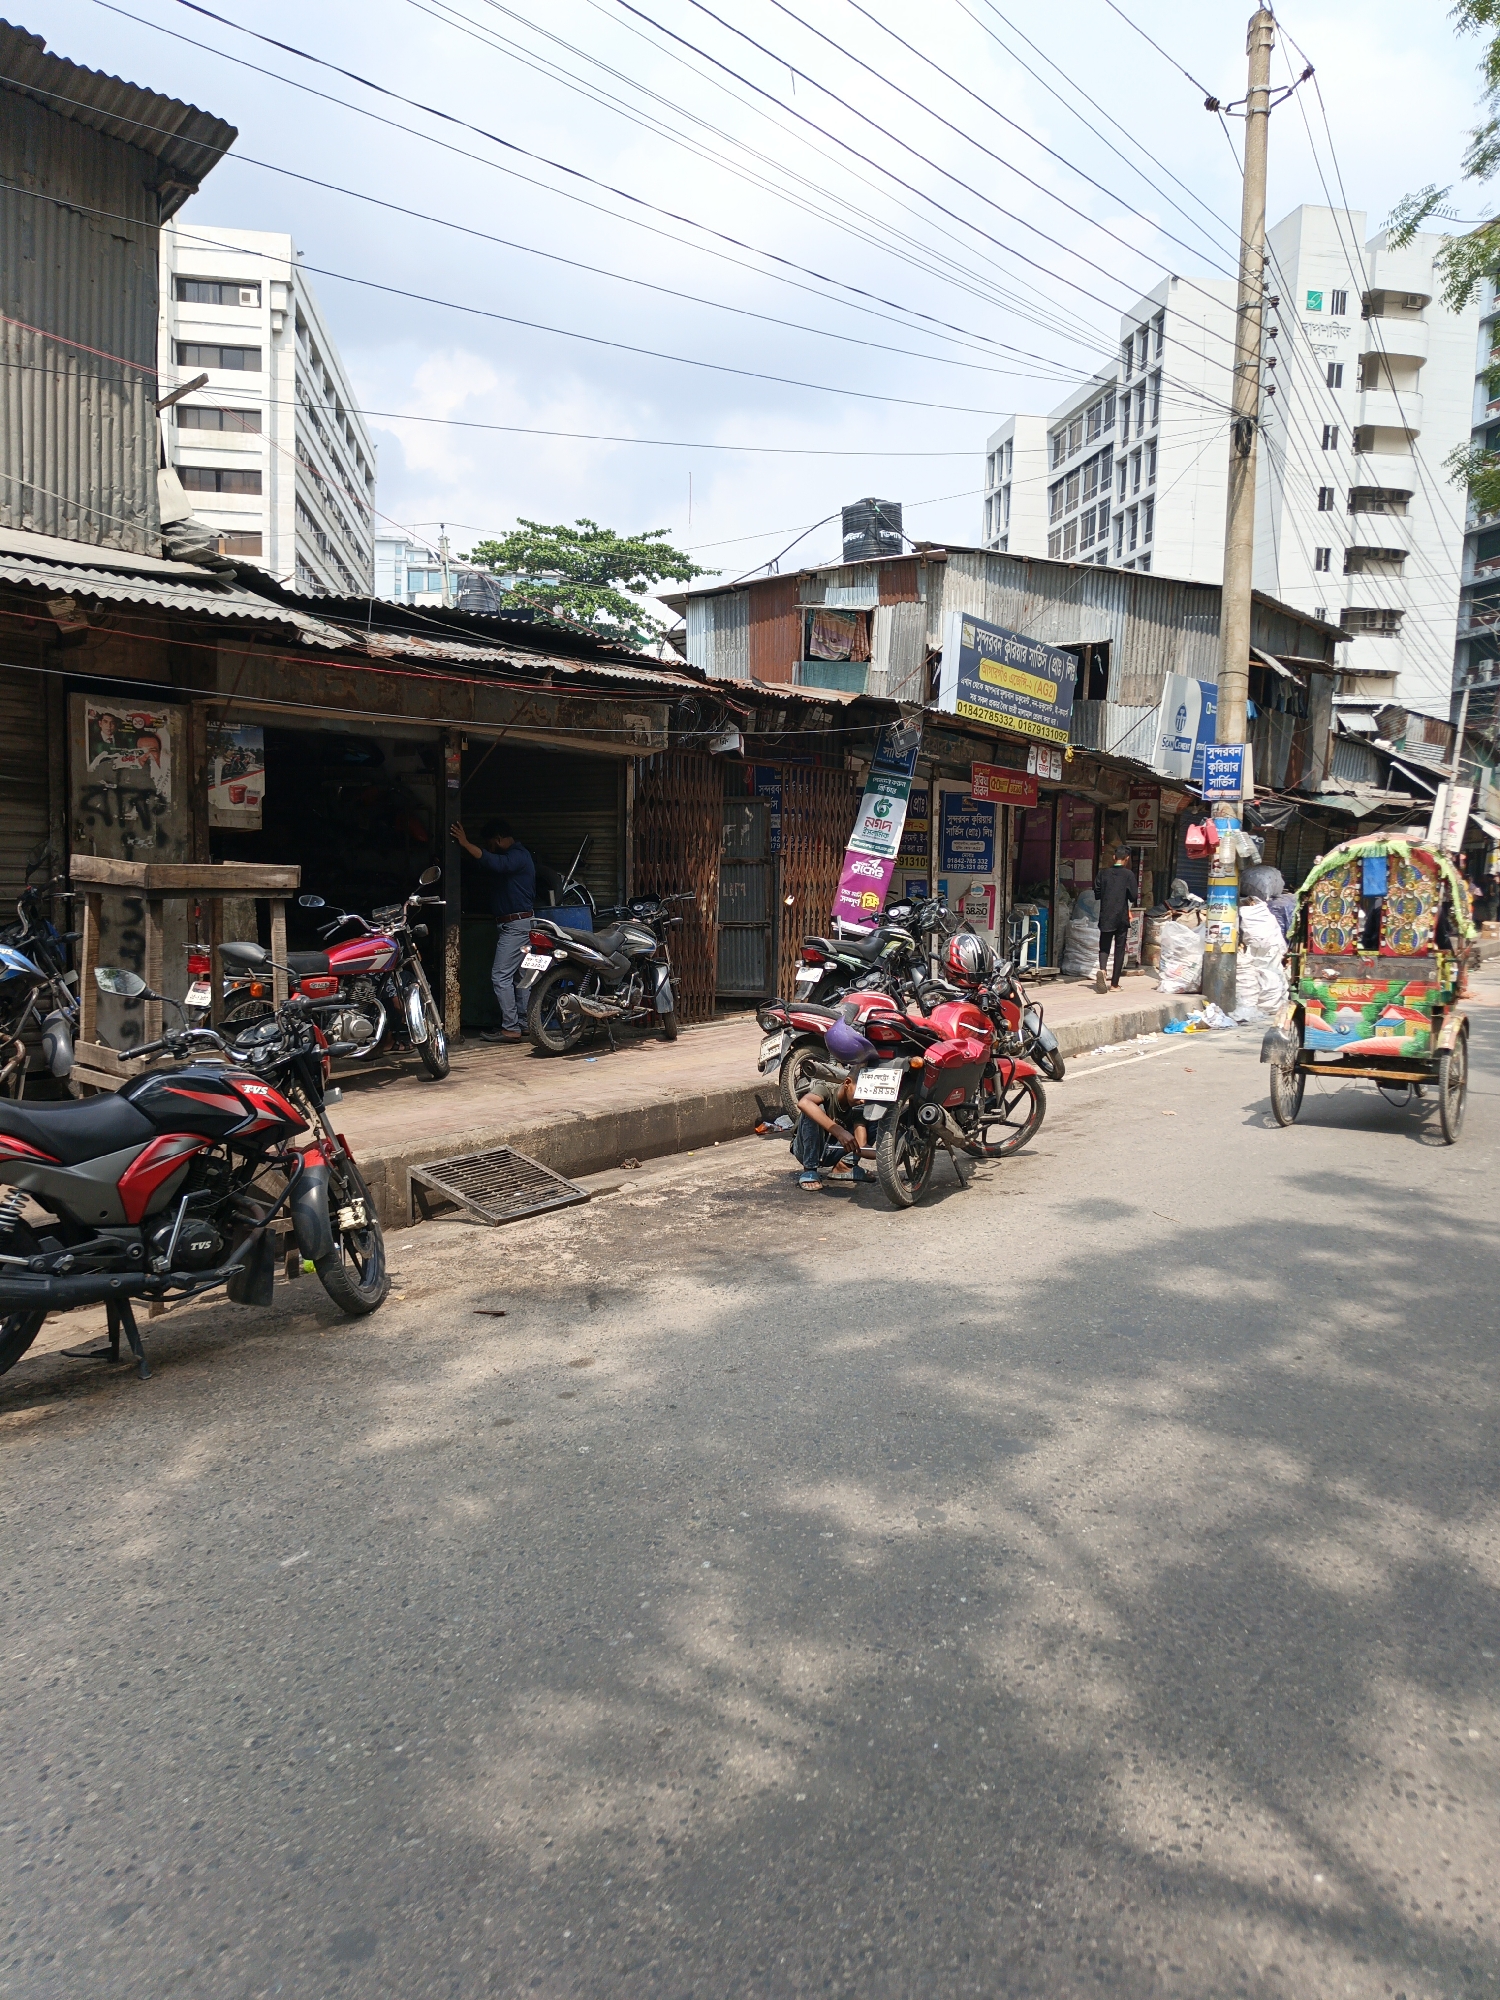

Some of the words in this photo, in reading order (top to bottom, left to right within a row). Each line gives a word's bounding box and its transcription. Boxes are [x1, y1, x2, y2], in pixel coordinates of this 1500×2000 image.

[976, 627, 1003, 656] সুন্দরবন
[1004, 634, 1029, 665] কুরিয়ার
[1029, 644, 1048, 671] সার্ভিস
[1034, 680, 1057, 702] (AG2)
[957, 701, 1015, 729] 01842785332,
[1018, 719, 1068, 742] 01879131092
[1207, 746, 1242, 759] সুন্দরবন
[1207, 760, 1240, 775] কুরিয়ার
[1208, 774, 1237, 788] সার্ভিস
[864, 816, 893, 833] নগদ
[947, 815, 970, 825] সুন্দরবন
[971, 813, 993, 826] কুরিয়ার
[1133, 819, 1154, 830] নগদ
[946, 825, 964, 837] সার্ভিস
[965, 827, 981, 839] (প্রাঃ)
[241, 1084, 269, 1095] TVS
[190, 1240, 212, 1250] TVS
